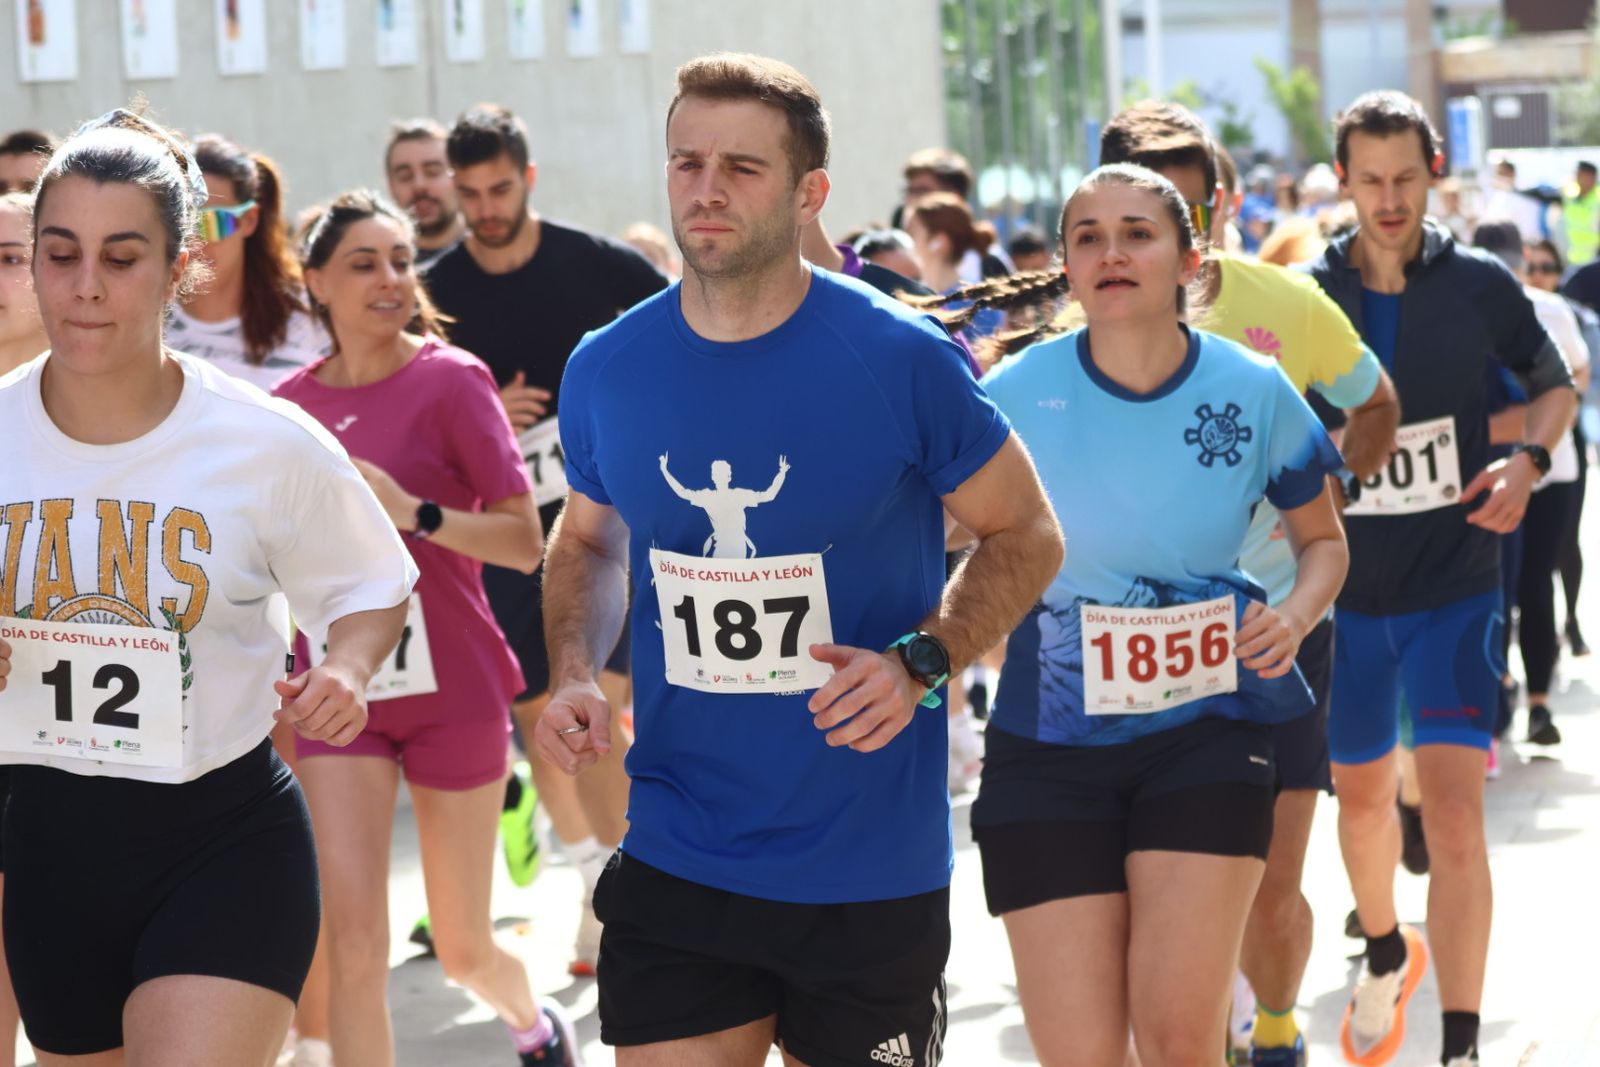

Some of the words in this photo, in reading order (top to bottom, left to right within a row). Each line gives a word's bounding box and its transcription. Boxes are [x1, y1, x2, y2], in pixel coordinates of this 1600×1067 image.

[1364, 441, 1438, 490] 01
[659, 560, 678, 576] DÍA
[680, 567, 695, 580] DE
[698, 570, 760, 582] CASTILLA
[762, 570, 771, 580] Y
[775, 565, 813, 580] LEÓN
[1086, 612, 1107, 623] DÍA
[1110, 616, 1124, 625] DE
[1130, 615, 1186, 625] CASTILLA
[1189, 612, 1196, 621] Y
[1199, 604, 1231, 618] LEÓN
[1, 628, 26, 639] DÍA
[30, 630, 48, 641] DE
[52, 631, 118, 647] CASTILLA
[120, 638, 129, 648] Y
[132, 638, 170, 652] LEÓN
[673, 595, 810, 661] 187
[1091, 622, 1229, 683] 1856
[42, 659, 140, 729] 12
[122, 740, 141, 749] Plena
[870, 1048, 914, 1067] adidas
